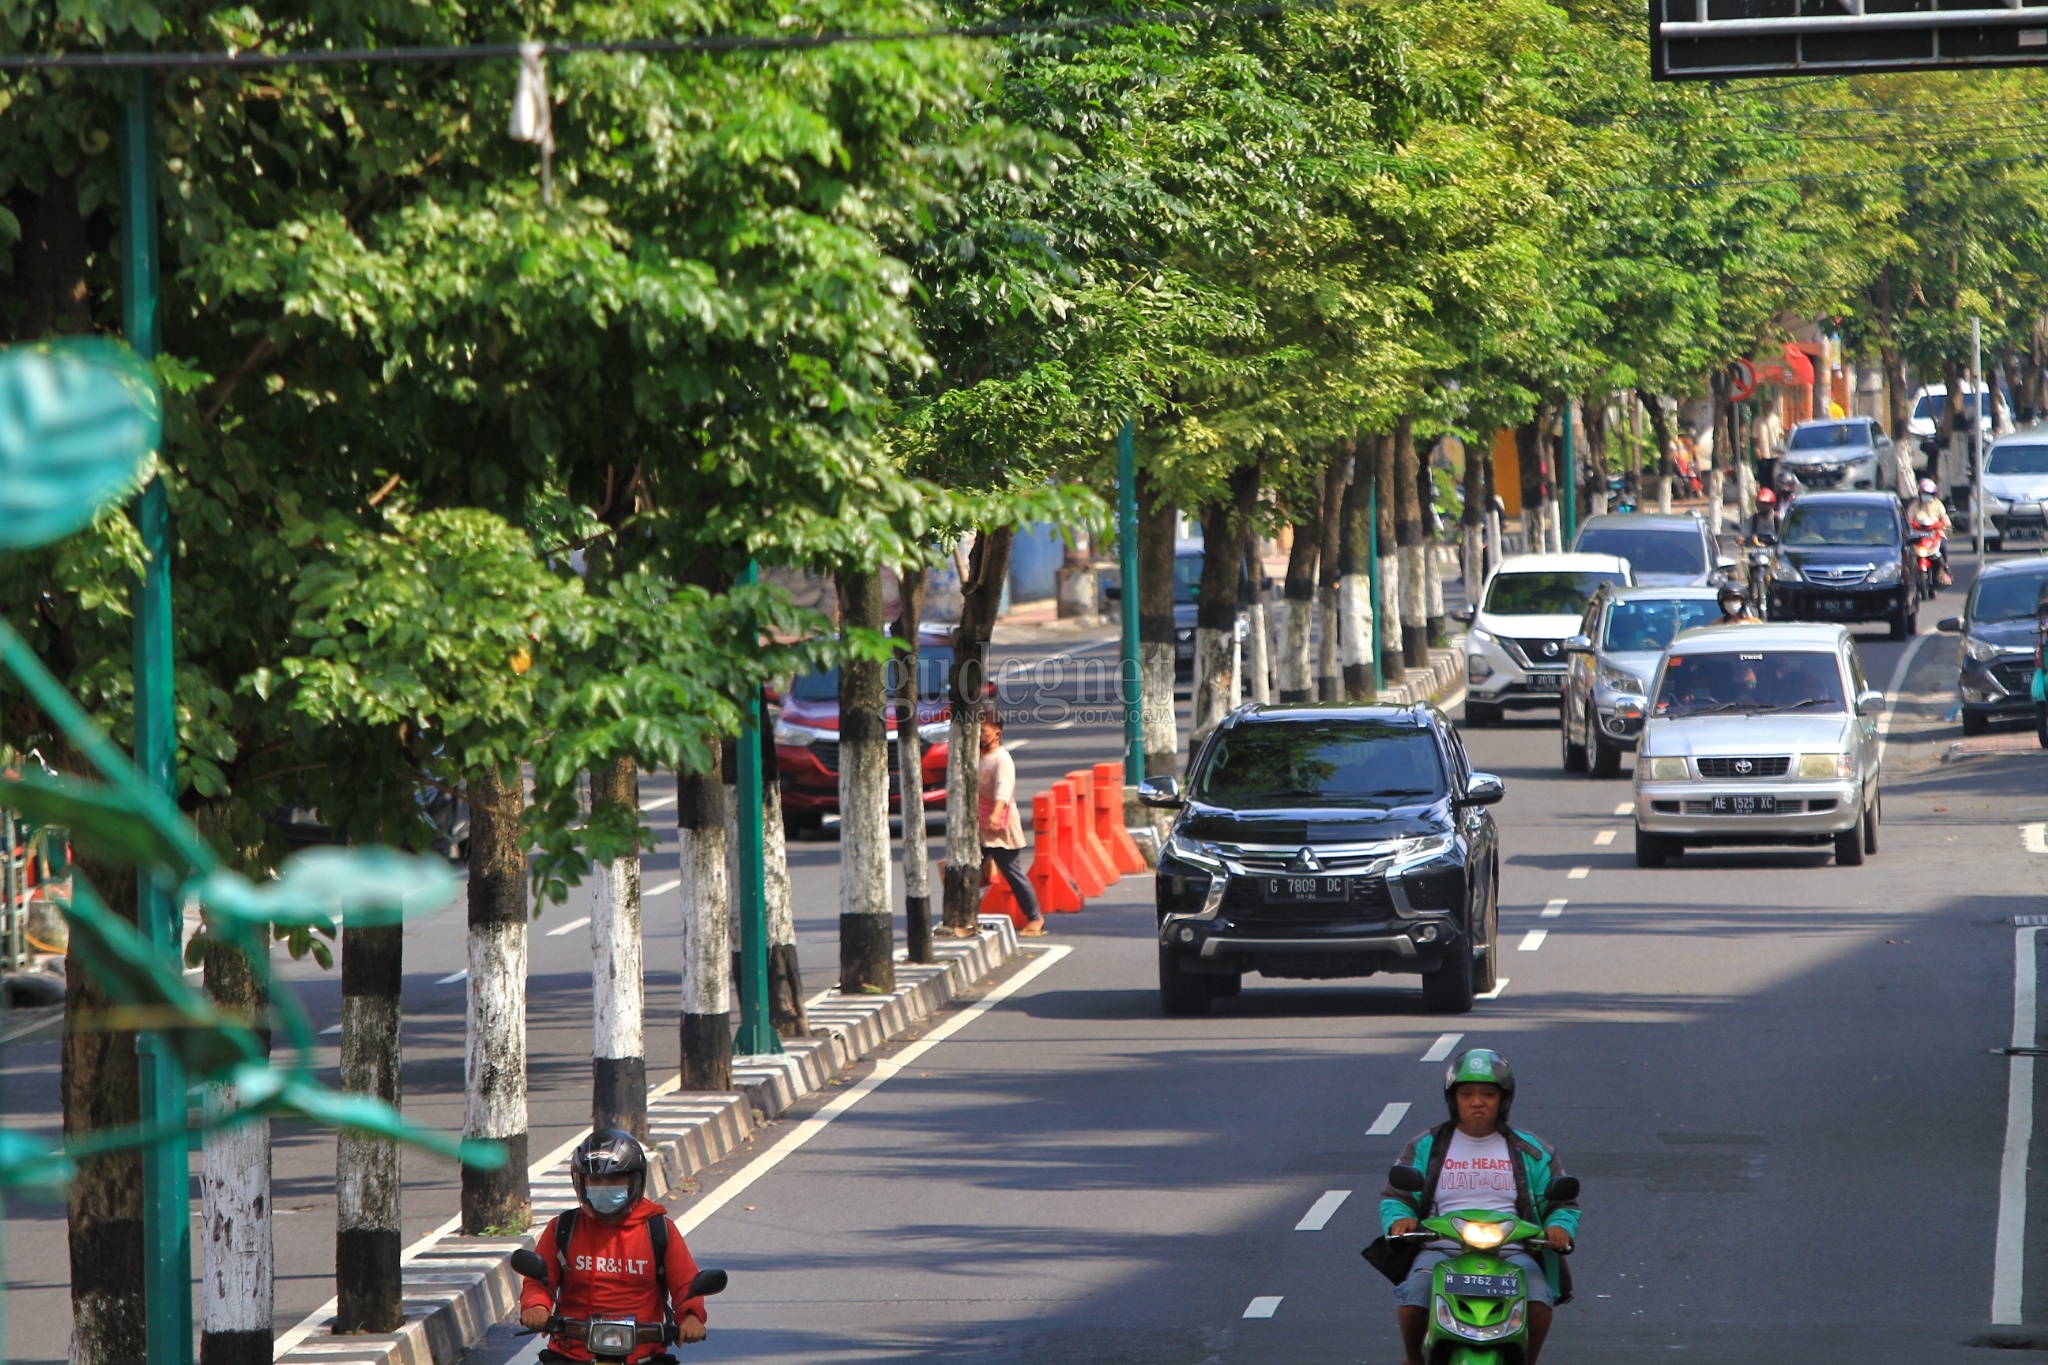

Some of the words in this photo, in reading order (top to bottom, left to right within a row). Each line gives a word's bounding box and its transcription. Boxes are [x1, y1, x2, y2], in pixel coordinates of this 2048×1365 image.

[1714, 797, 1726, 809] AE
[1733, 797, 1755, 809] 1525
[1270, 879, 1278, 893] G
[1287, 878, 1316, 893] 7809
[1327, 878, 1341, 892] DC
[1444, 1158, 1469, 1170] One
[1472, 1158, 1513, 1171] HEART
[1446, 1274, 1454, 1284] H
[1463, 1275, 1492, 1286] 3762
[1501, 1278, 1518, 1287] KY
